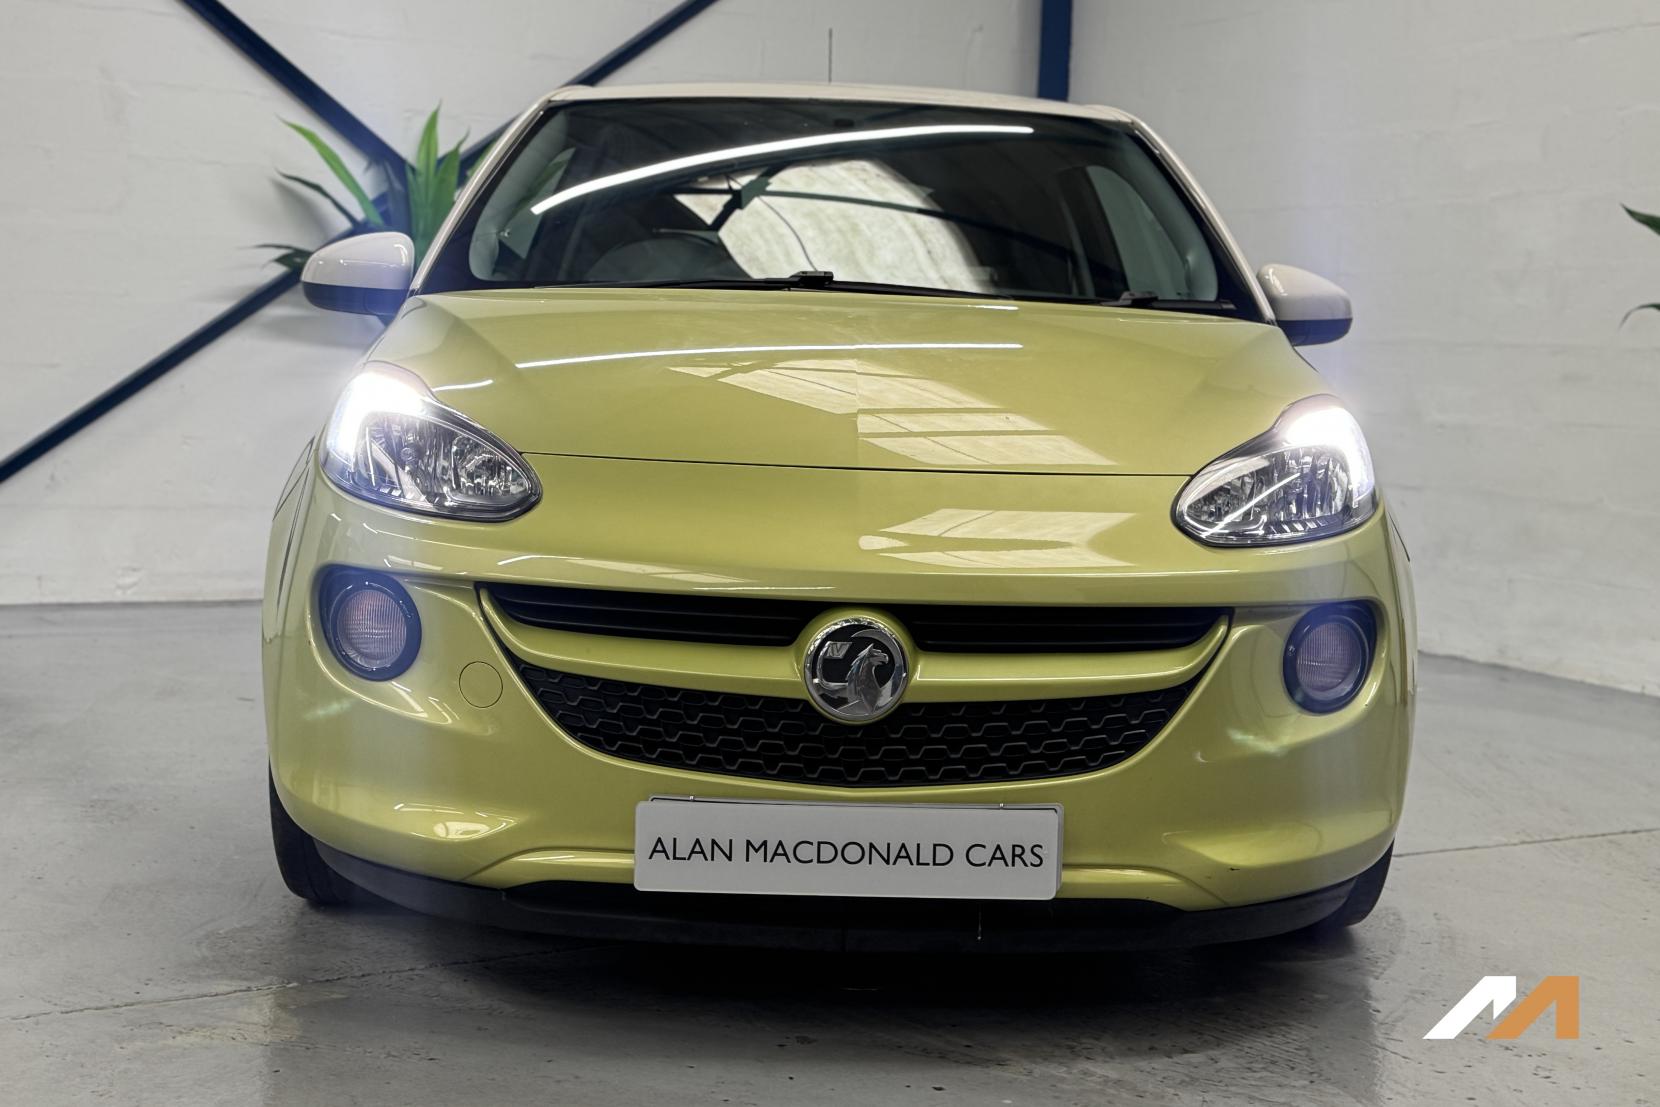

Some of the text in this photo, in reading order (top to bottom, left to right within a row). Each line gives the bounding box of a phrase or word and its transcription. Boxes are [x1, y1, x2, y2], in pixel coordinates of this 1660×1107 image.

[648, 836, 1044, 868] ALAN MACDONALD CARS
